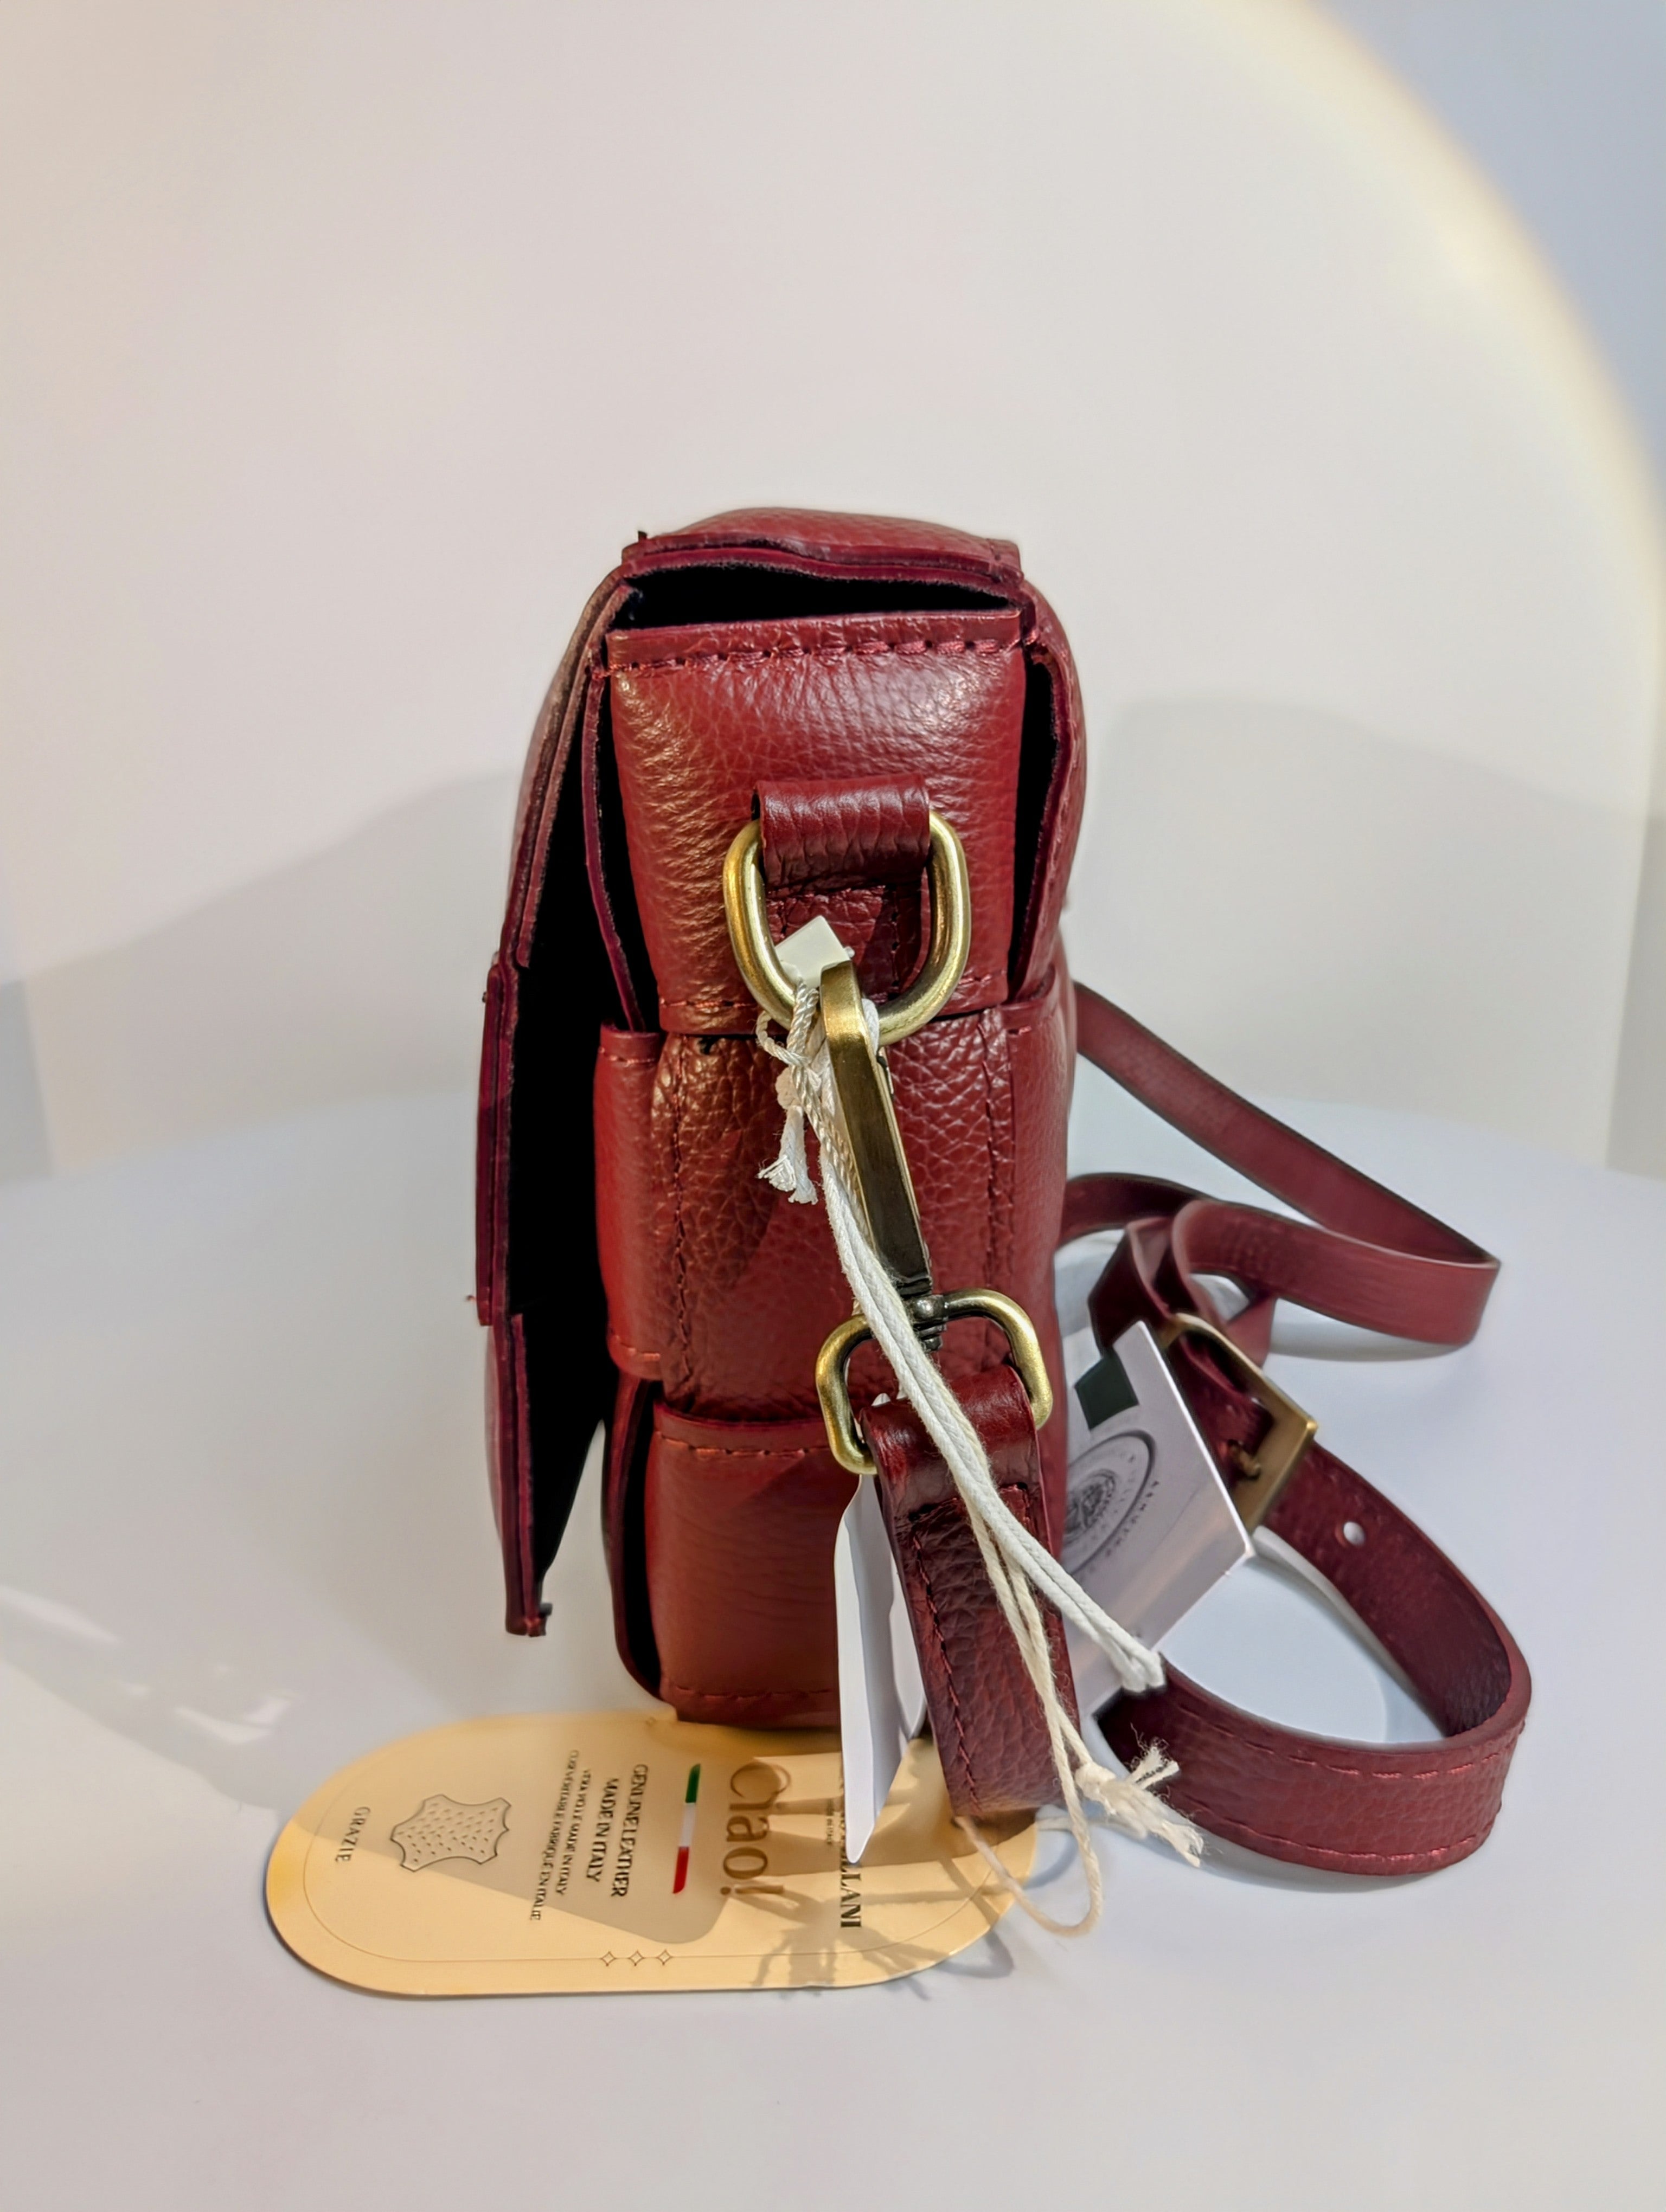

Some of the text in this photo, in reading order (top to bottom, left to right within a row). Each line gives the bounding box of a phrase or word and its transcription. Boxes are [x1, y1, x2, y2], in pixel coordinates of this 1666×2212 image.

[334, 1806, 371, 1862] GRAZIE
[565, 1823, 581, 1852] MADE
[585, 1778, 618, 1883] MADE IN ITALY
[610, 1764, 648, 1898] GENUINE LEATHER
[720, 1762, 791, 1896] Ciao!
[561, 1855, 573, 1865] IN
[537, 1872, 551, 1886] EN
[554, 1867, 571, 1896] ITALY
[529, 1888, 546, 1921] ITALIE
